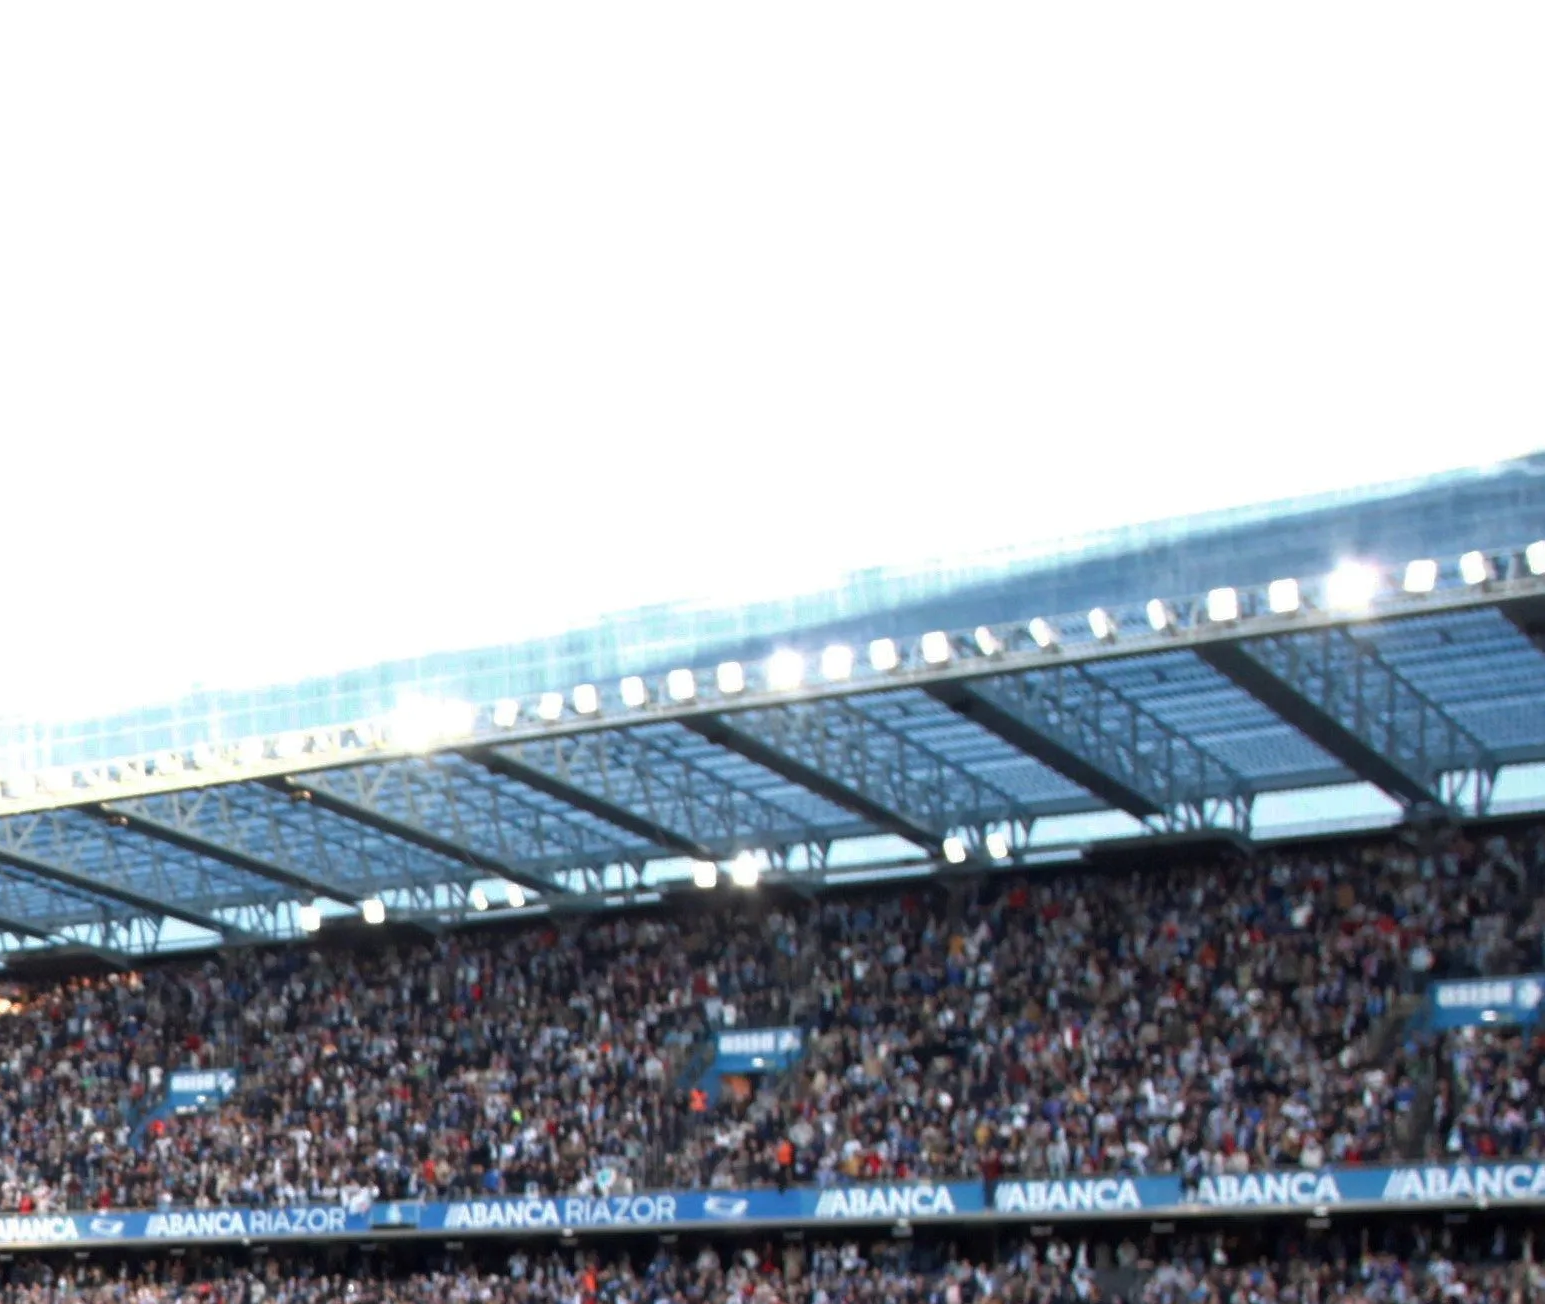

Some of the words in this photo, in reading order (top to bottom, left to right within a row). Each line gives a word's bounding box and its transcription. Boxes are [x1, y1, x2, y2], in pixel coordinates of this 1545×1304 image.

[1196, 1172, 1341, 1204] ABANCA
[249, 1208, 346, 1233] RIAZOR
[565, 1197, 676, 1222] RIAZOR
